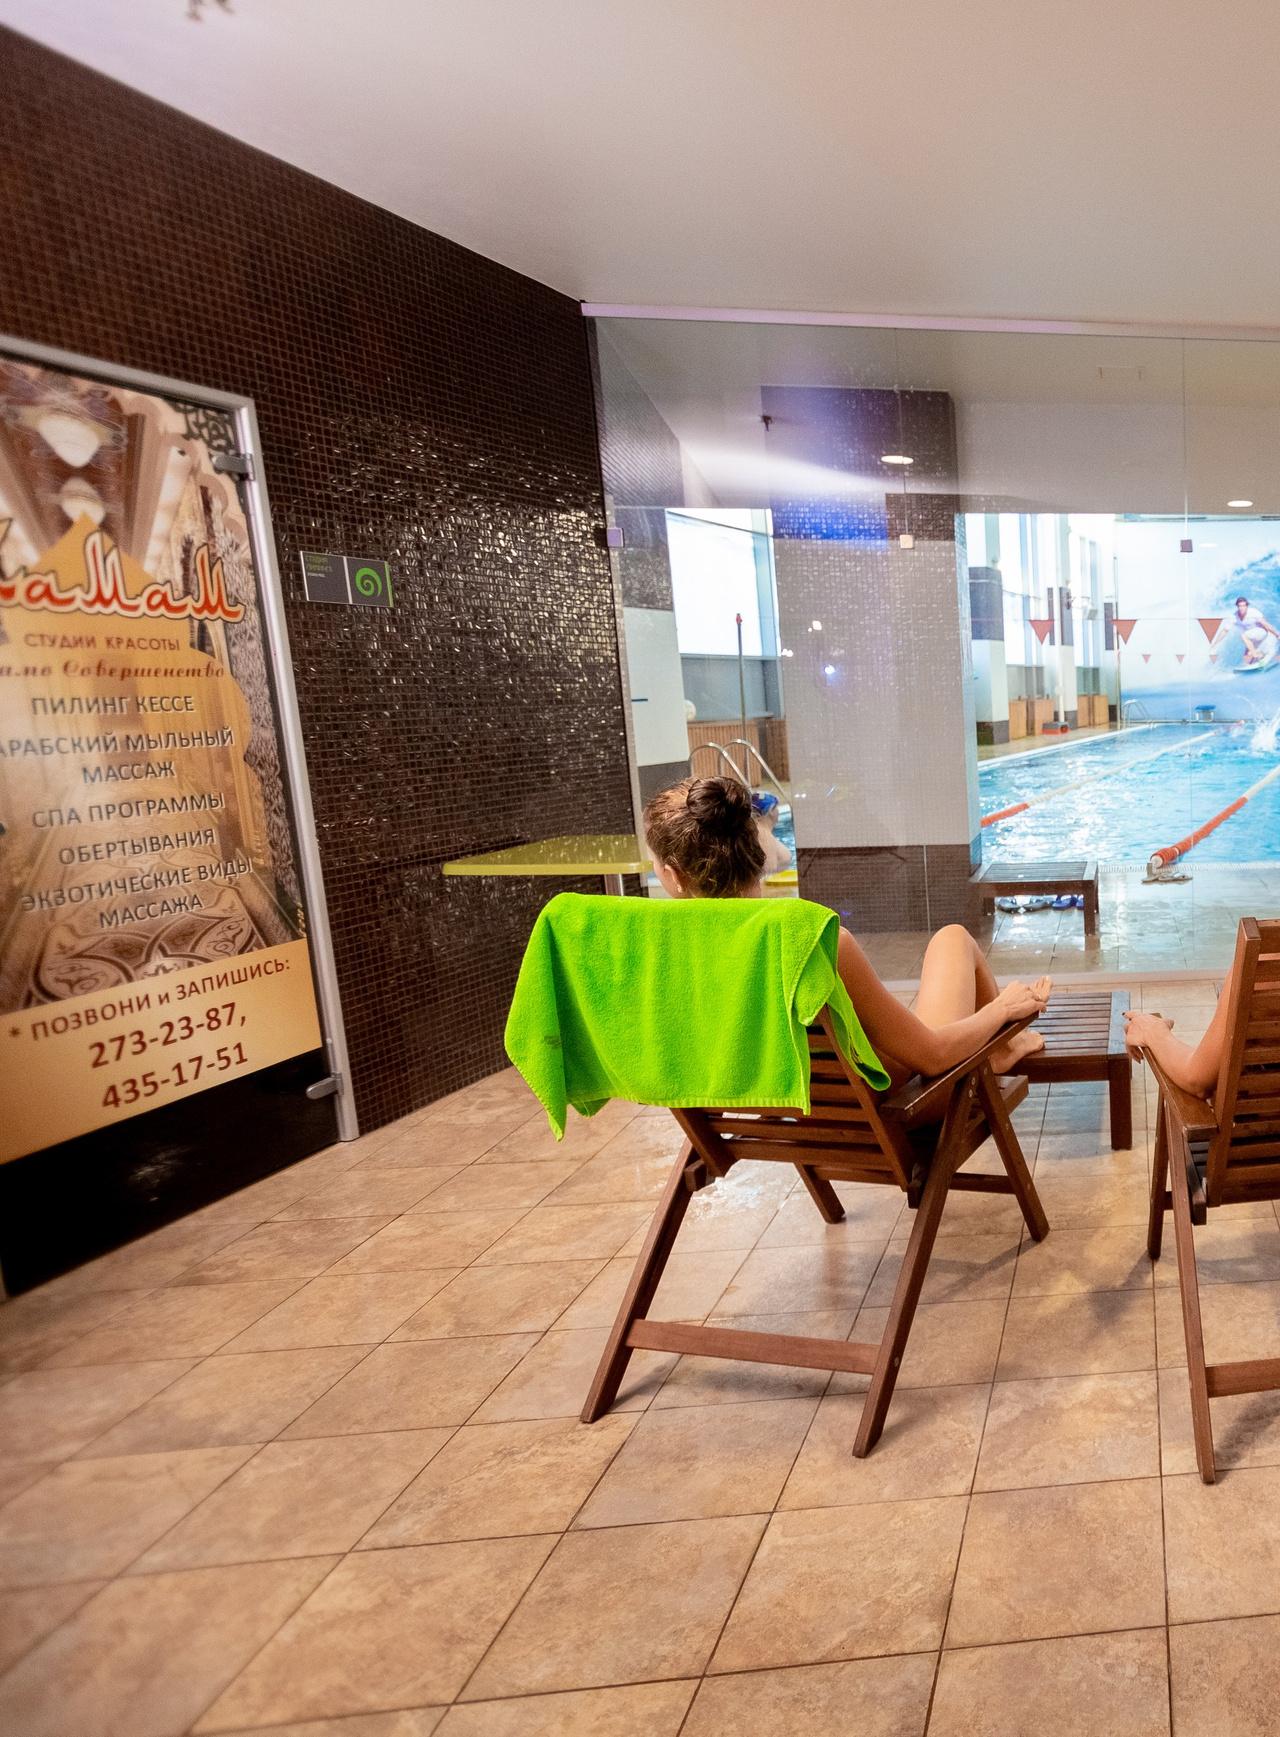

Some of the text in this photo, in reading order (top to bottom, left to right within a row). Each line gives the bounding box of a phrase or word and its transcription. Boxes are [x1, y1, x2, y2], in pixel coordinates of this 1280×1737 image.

[0, 519, 246, 623] аМаМ
[24, 633, 180, 651] СТУДИИ КРАСОТЫ
[63, 659, 224, 681] Совершенство
[32, 695, 196, 715] ПИЛИНГ КЕССЕ
[126, 726, 235, 751] МЫЛЬНЫЙ
[82, 761, 175, 783] МАССАЖ
[32, 793, 225, 828] СПА ПРОГРАММЫ
[59, 829, 217, 865] ОБЕРТЫВАНИЯ
[22, 858, 253, 912] ЭКЗОТИЧЕСКИЕ ВИДЫ
[100, 894, 204, 929] МАССАЖА
[31, 994, 151, 1041] ПОЗВОНИ
[176, 958, 290, 1001] ЗАПИШИСЬ:
[89, 1002, 246, 1069] 273-23-87,
[102, 1042, 248, 1108] 435-17-51
